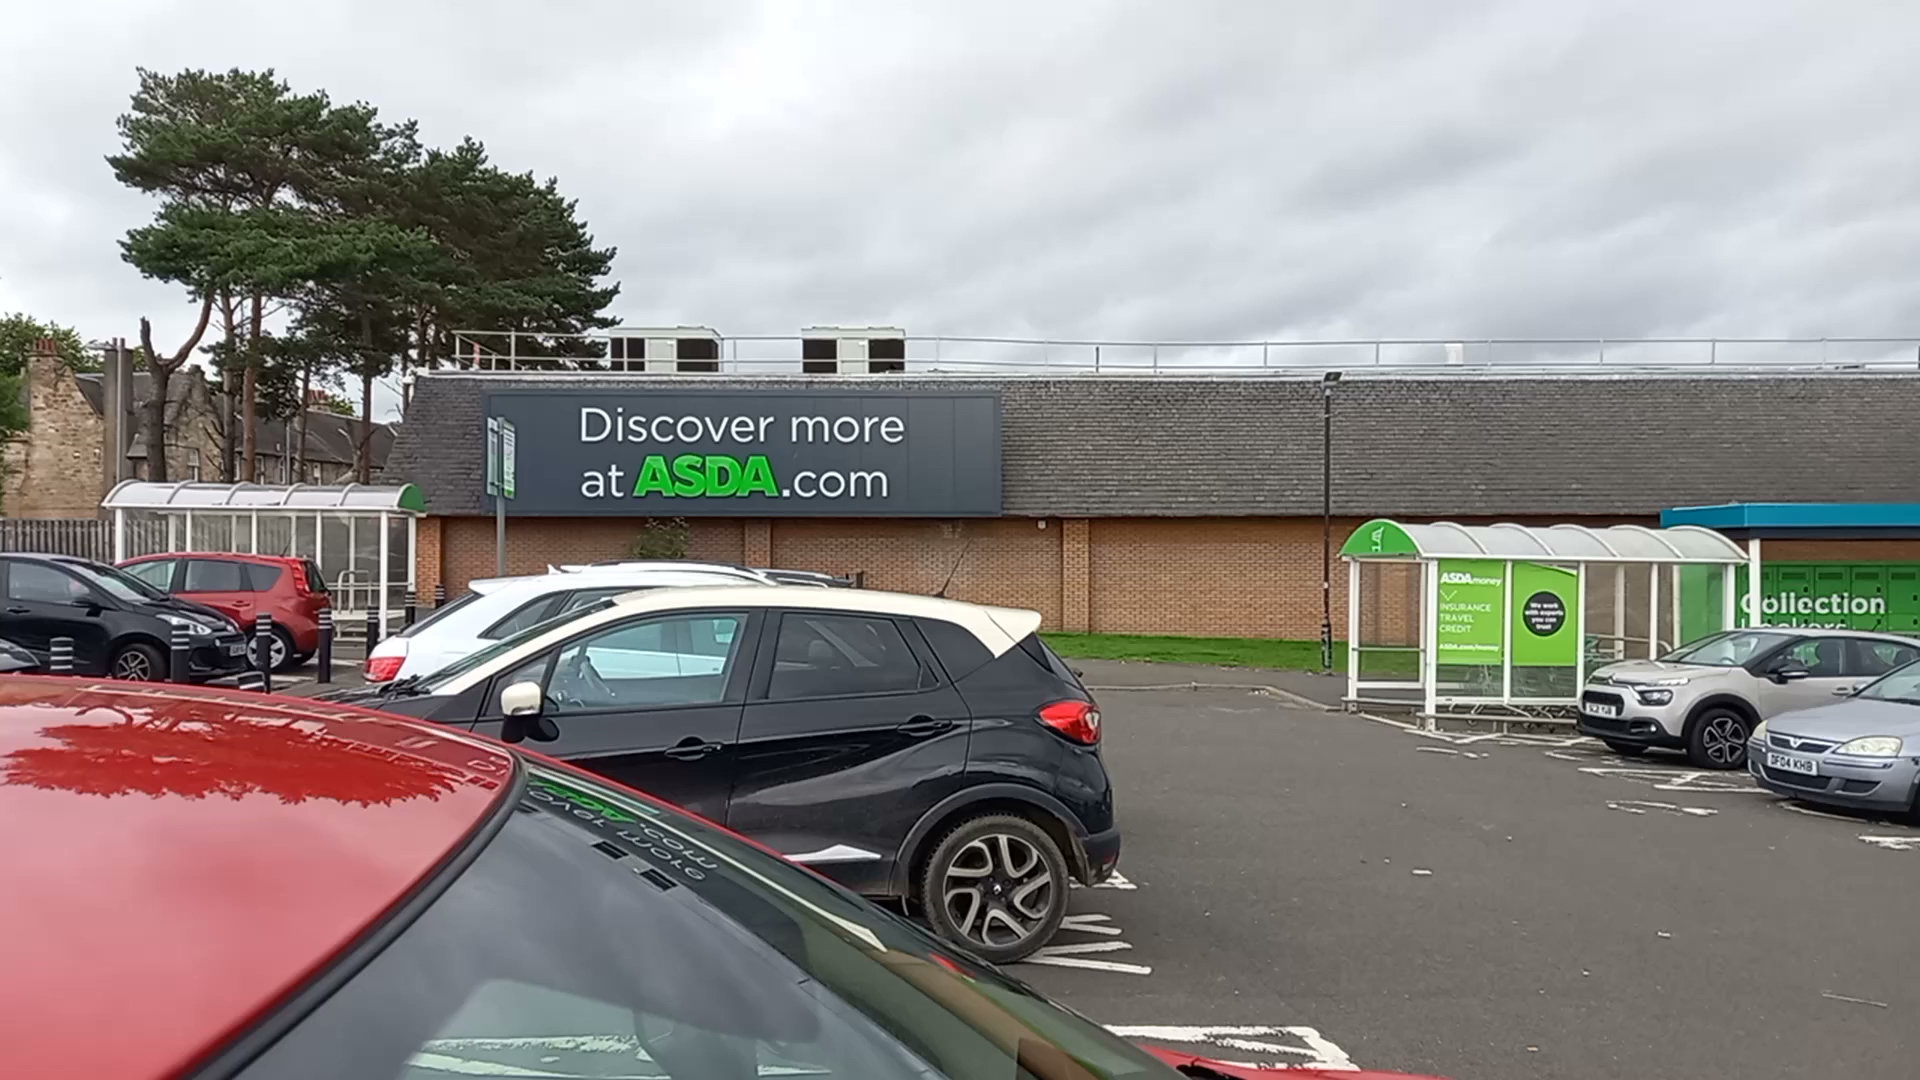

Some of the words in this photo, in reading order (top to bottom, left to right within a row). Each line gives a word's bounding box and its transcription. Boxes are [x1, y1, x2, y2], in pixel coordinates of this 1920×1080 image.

[580, 407, 775, 443] Discover
[791, 415, 905, 443] more
[581, 462, 624, 498] at
[1439, 603, 1492, 613] INSURANCE
[1439, 613, 1475, 623] TRAVEL
[1439, 624, 1472, 633] CREDIT
[1793, 759, 1813, 773] KHB
